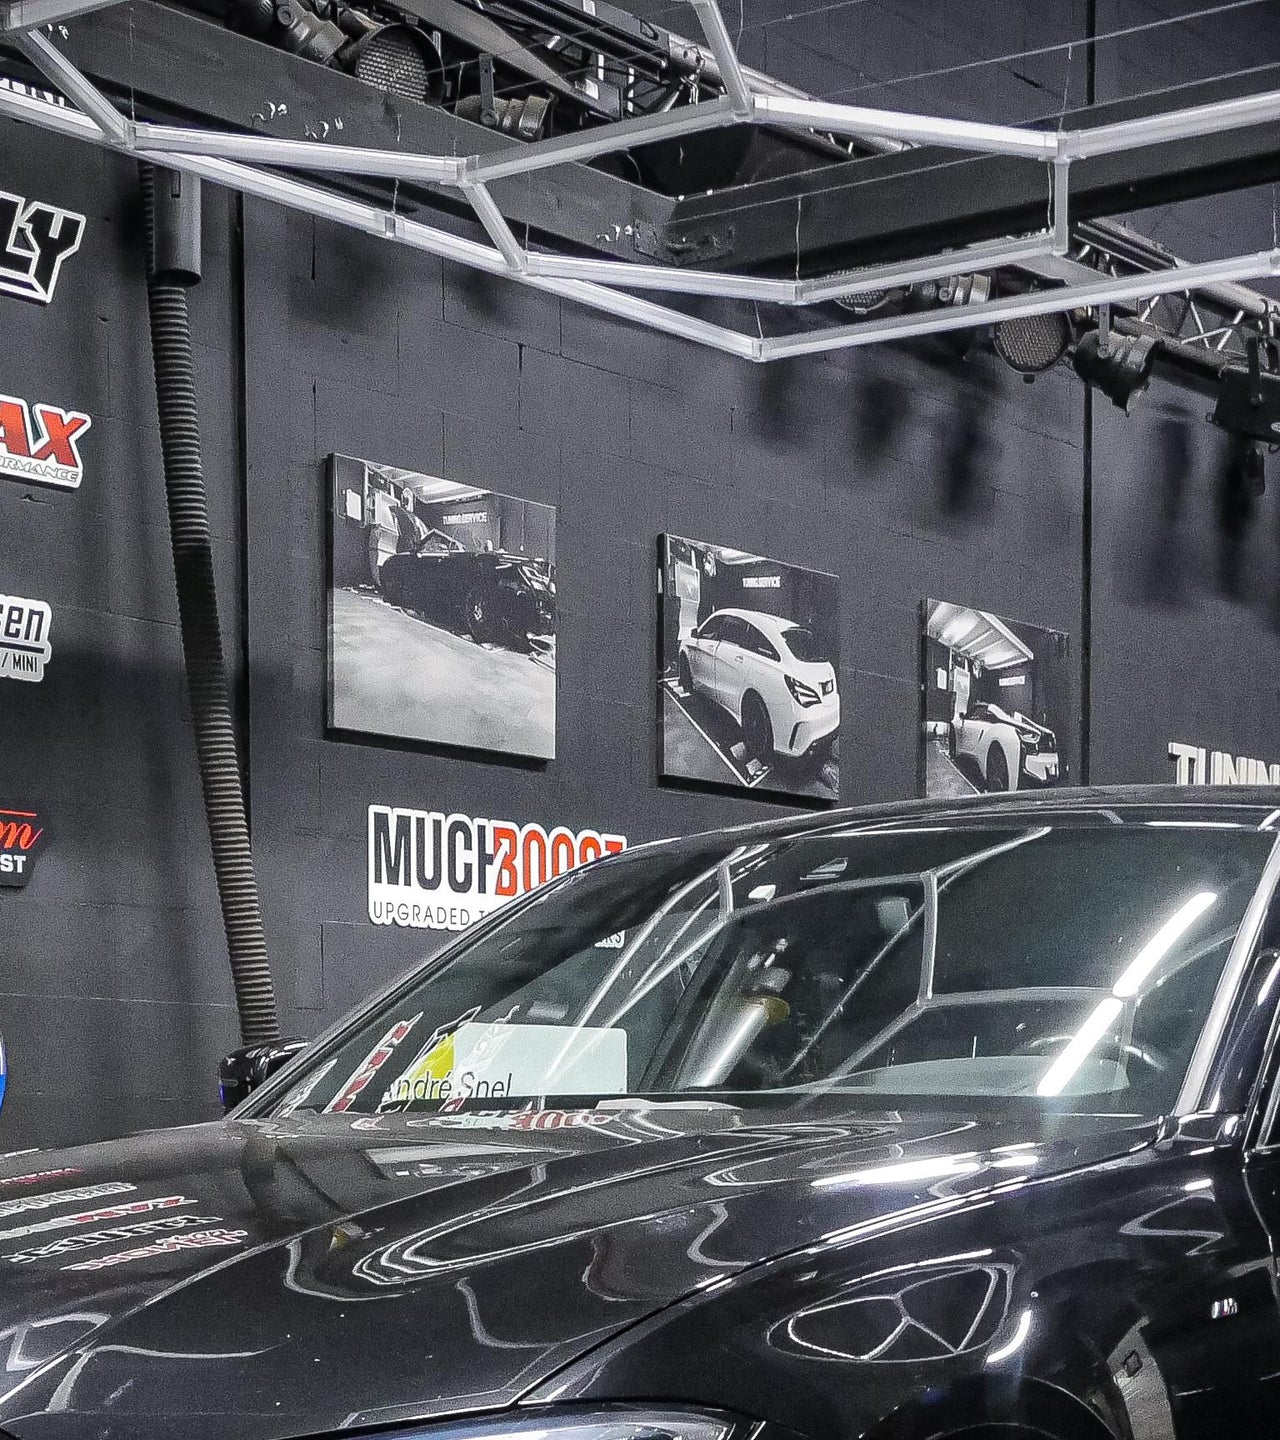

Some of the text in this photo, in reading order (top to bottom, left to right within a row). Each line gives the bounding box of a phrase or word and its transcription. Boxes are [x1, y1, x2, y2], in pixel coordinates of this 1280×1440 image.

[12, 653, 39, 673] MINI
[373, 900, 470, 926] UPGRADED
[396, 1071, 452, 1100] ndré
